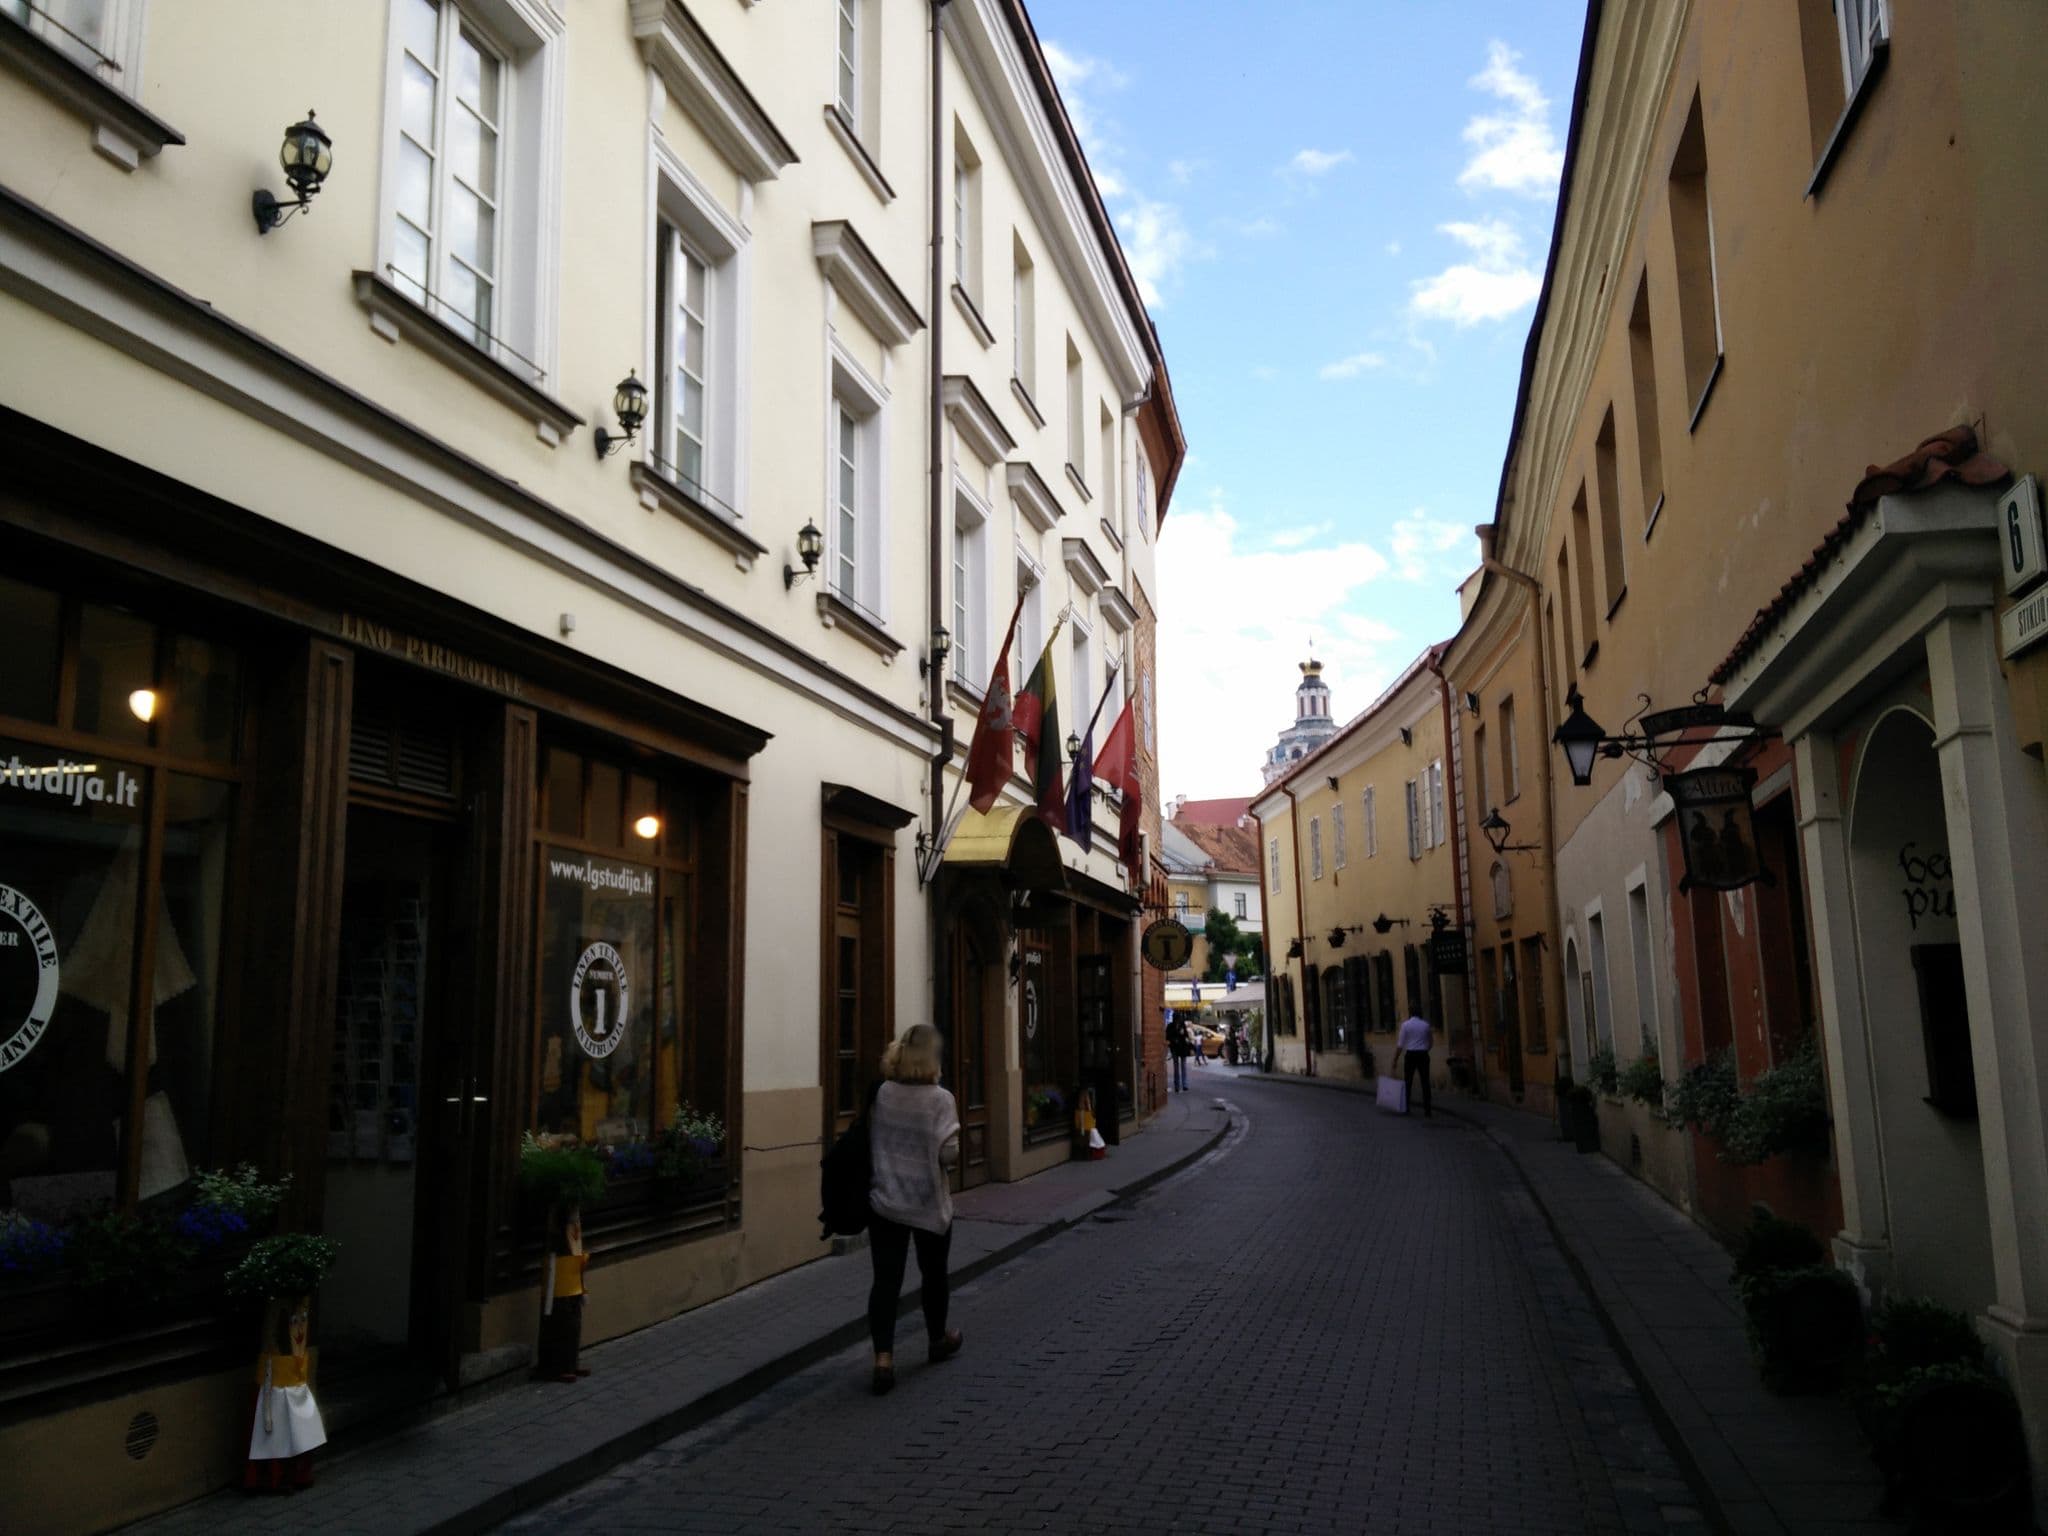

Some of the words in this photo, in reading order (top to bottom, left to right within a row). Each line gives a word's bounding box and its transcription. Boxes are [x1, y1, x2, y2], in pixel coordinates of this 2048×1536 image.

[2007, 500, 2024, 574] 6
[341, 612, 392, 650] LINO
[550, 860, 653, 896] www.lgstudija.lt
[574, 948, 596, 989] LINEN
[599, 945, 628, 992] TEXTILE
[593, 988, 607, 1035] 1
